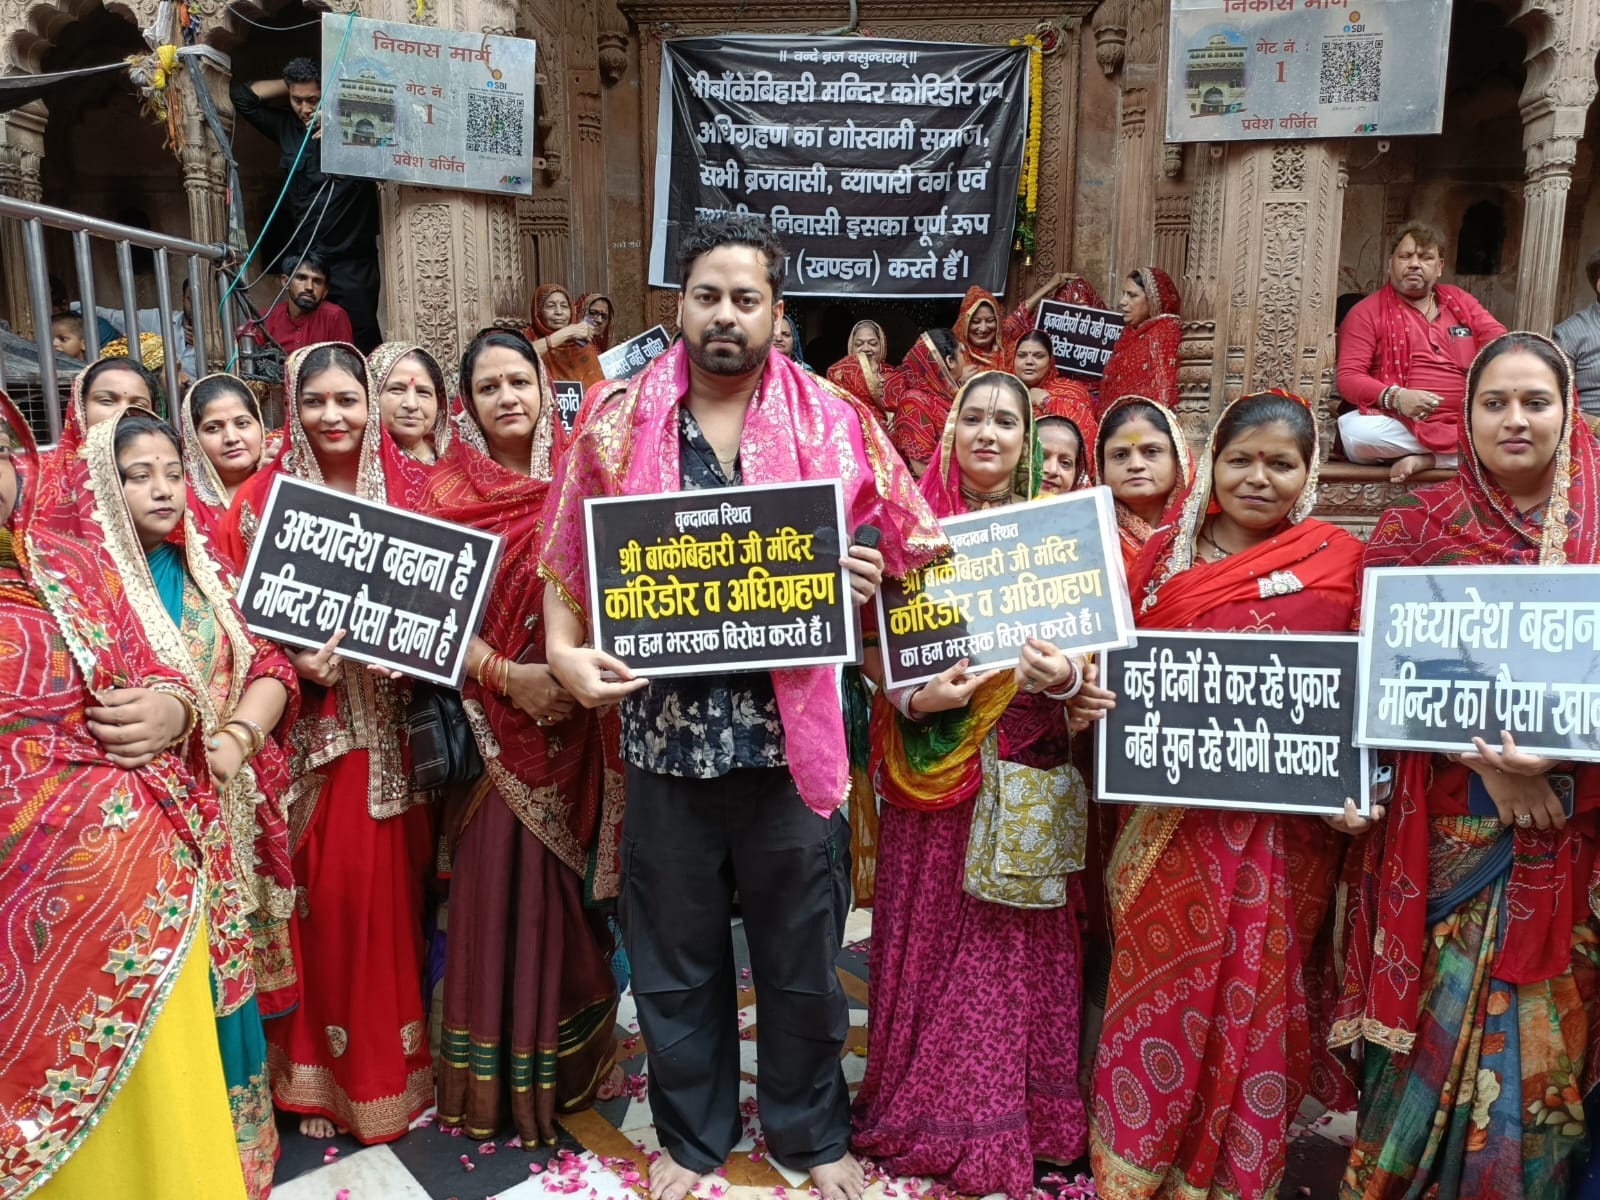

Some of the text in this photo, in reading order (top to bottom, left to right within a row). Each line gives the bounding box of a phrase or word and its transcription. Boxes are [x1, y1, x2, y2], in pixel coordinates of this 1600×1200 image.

[372, 30, 492, 65] निकास मार्ग
[793, 48, 820, 63] वन्दे
[822, 51, 844, 64] ब्रज
[1256, 38, 1278, 54] गेट
[405, 79, 426, 96] गेट
[821, 72, 887, 104] मन्दिर
[891, 73, 976, 107] कोरिडोर
[1274, 61, 1287, 83] 1
[424, 103, 434, 125] 1
[697, 114, 790, 150] अधिग्रहण
[794, 127, 824, 148] का
[829, 118, 916, 150] गोस्वामी
[1241, 112, 1318, 131] प्रवेश वर्जित
[392, 153, 466, 173] प्रवेश वर्जित
[700, 158, 991, 195] सभी ब्रजवासी, व्यापारी वर्ग एवं
[770, 205, 840, 235] निवासी
[845, 216, 909, 240] इसका
[914, 205, 948, 247] पूर्ण
[952, 214, 991, 235] रूप
[797, 248, 881, 287] (खण्डन)
[888, 250, 939, 279] करते
[1079, 314, 1091, 336] की
[1090, 316, 1105, 339] यही
[627, 343, 647, 366] नहीं
[1073, 344, 1100, 367] यमुना
[1100, 349, 1113, 365] पा
[674, 503, 752, 533] वृन्दावन स्थित
[991, 523, 1019, 543] स्थित
[275, 509, 477, 600] अध्यादेश बहाना है
[619, 526, 814, 575] श्री बांकेबिहारी जी मंदिर
[1009, 543, 1030, 572] जी
[1033, 535, 1079, 565] मंदिर
[604, 566, 836, 620] कॉरिडोर व अधिग्रहण
[889, 569, 1102, 635] कॉरिडोर व अधिग्रहण
[252, 563, 459, 667] मन्दिर का पैसा खाना है
[1385, 587, 1600, 652] अध्यादेश बहान
[614, 635, 635, 657] का
[638, 633, 663, 658] हम
[666, 629, 720, 654] भरसक
[722, 621, 766, 650] विरोध
[768, 617, 807, 647] करते
[900, 647, 920, 668] का
[921, 642, 945, 666] हम
[945, 631, 995, 658] भरसक
[997, 622, 1038, 649] विरोध
[1040, 612, 1078, 641] करते
[1123, 647, 1341, 725] कई दिनों से कर रहे पुकार
[1378, 661, 1451, 728] मन्दिर
[1453, 680, 1490, 730] का
[1494, 663, 1547, 732] पैसा
[1124, 710, 1341, 784] नहीं सुन रहे योगी सरकार
